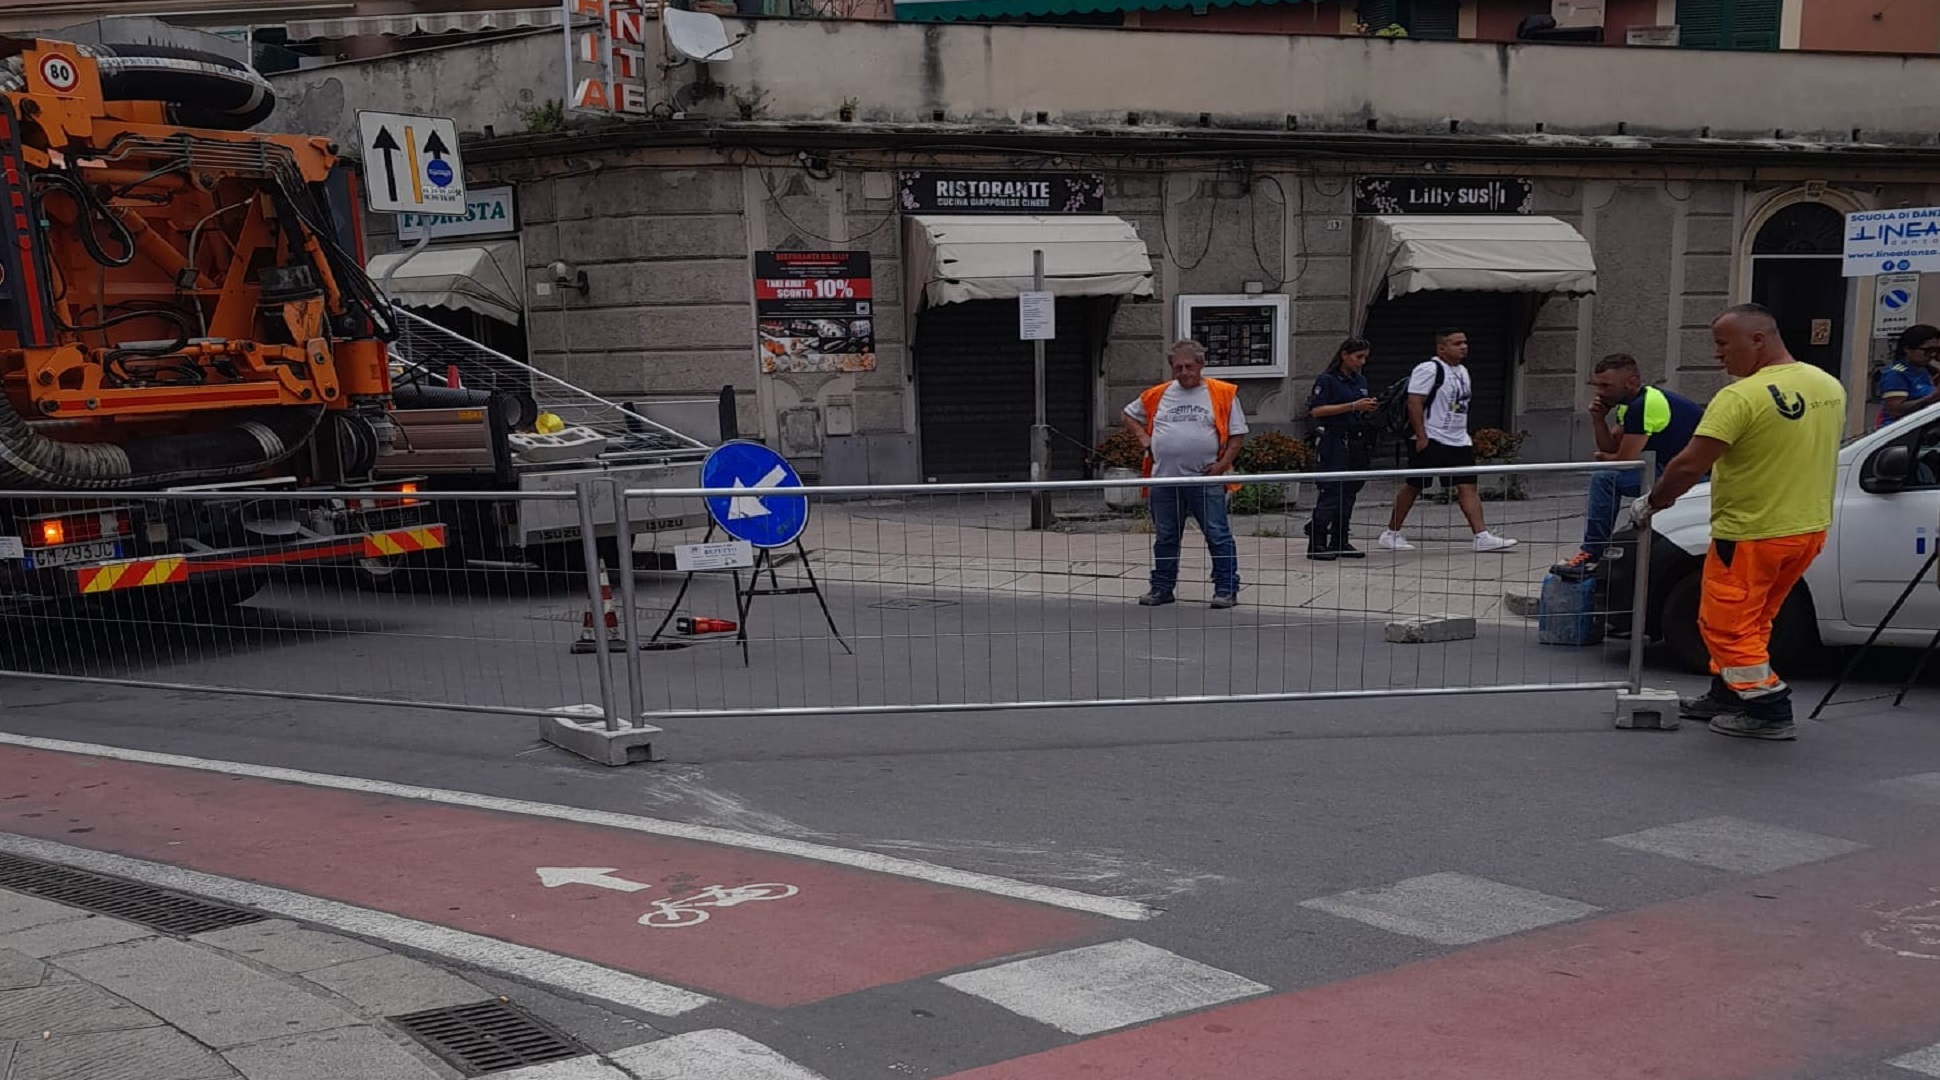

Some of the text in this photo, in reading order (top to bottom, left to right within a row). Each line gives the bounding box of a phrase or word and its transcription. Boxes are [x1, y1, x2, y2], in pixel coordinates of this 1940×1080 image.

[49, 63, 70, 82] 80
[936, 180, 1050, 198] RISTORANTE
[1409, 187, 1455, 206] Lilly
[937, 198, 1050, 207] CUCINA GIAPPONESE CINESE
[1851, 212, 1895, 221] SCUOLA
[1848, 221, 1939, 245] LINEA
[776, 288, 813, 299] SCONTO
[815, 278, 854, 298] 10%
[646, 518, 684, 531] ISUZU
[540, 528, 582, 540] ISUZU
